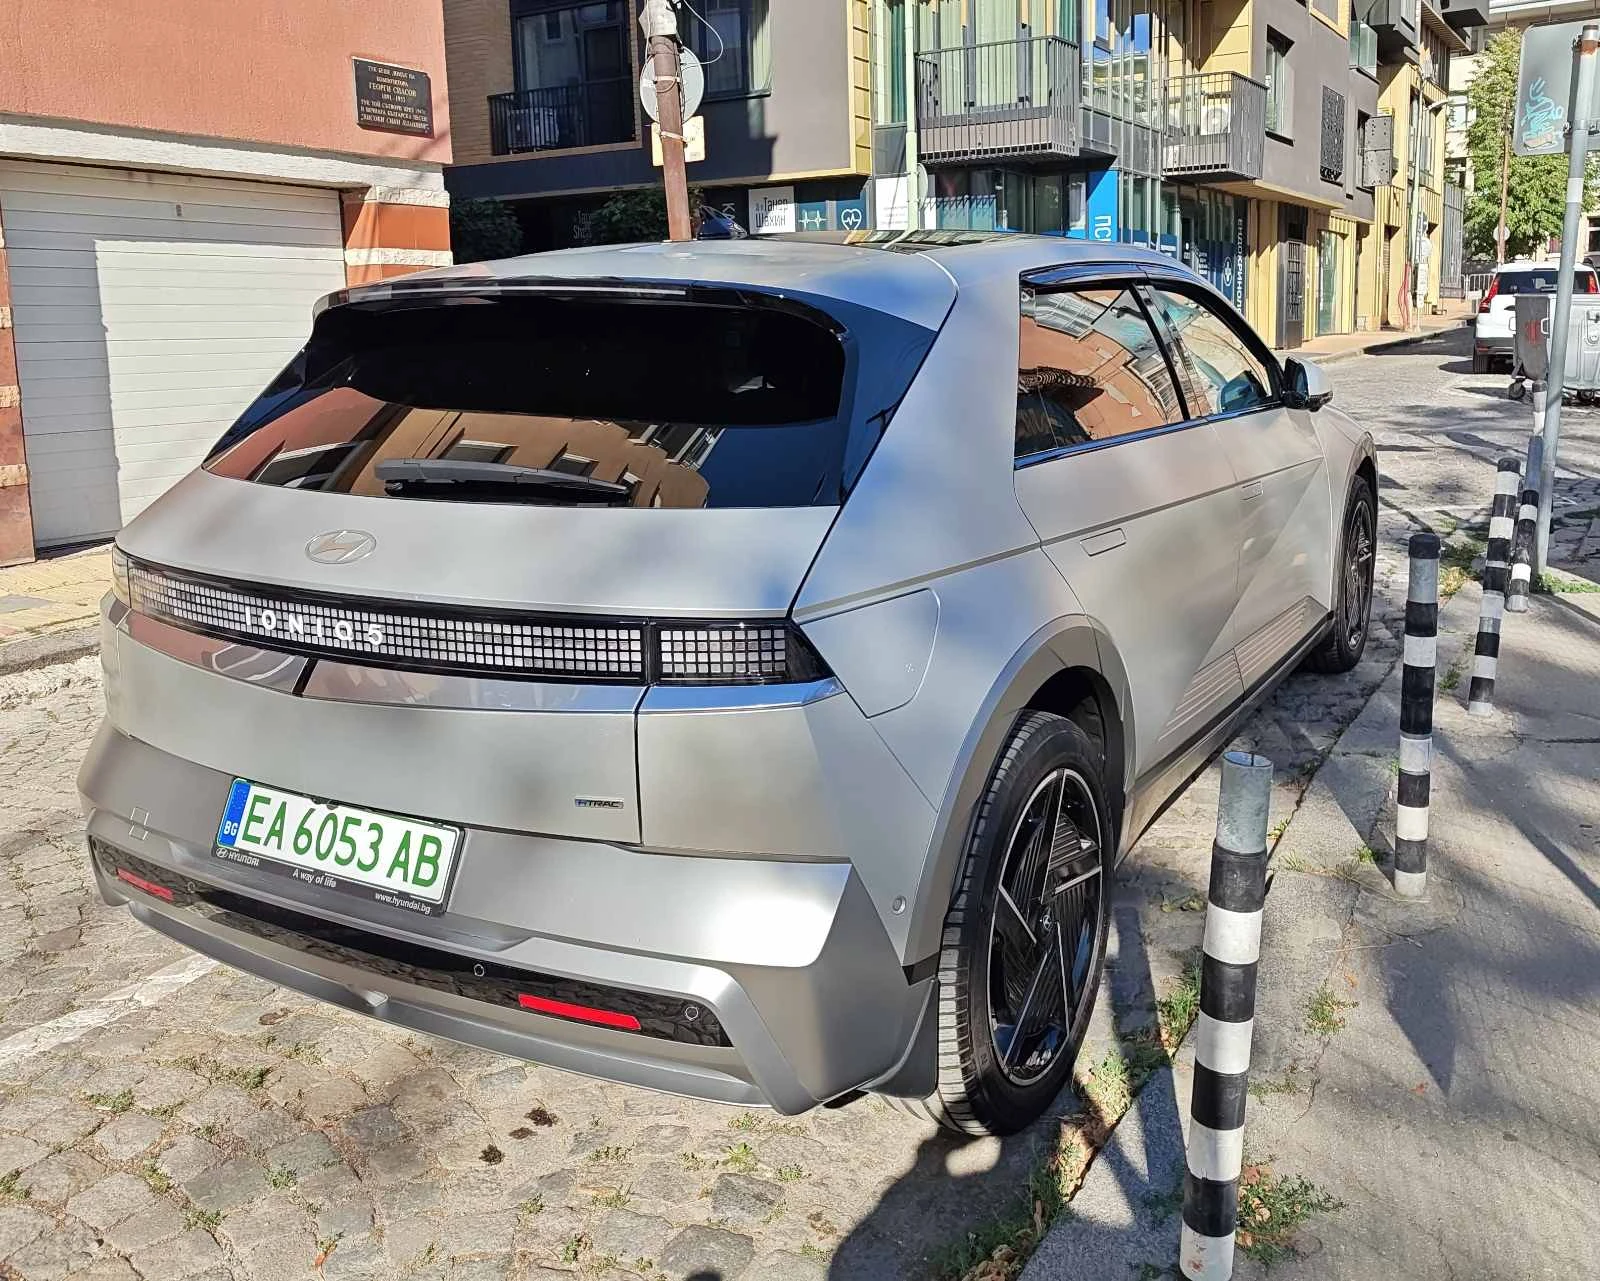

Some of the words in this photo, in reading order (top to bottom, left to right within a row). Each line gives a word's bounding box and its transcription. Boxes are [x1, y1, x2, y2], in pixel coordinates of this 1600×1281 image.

[764, 197, 788, 211] Танер
[755, 212, 786, 228] Шахин
[1094, 215, 1111, 242] ПС
[245, 606, 354, 642] IONIQ
[368, 623, 383, 645] 5
[223, 821, 238, 837] BG
[242, 794, 287, 850] EA
[293, 808, 384, 872] 6053
[386, 830, 443, 888] AB
[228, 851, 260, 866] HYUNDAI
[293, 869, 299, 879] A
[299, 871, 315, 883] way
[316, 875, 324, 885] of
[324, 876, 337, 888] life
[375, 892, 431, 915] www.hyundai.bg
